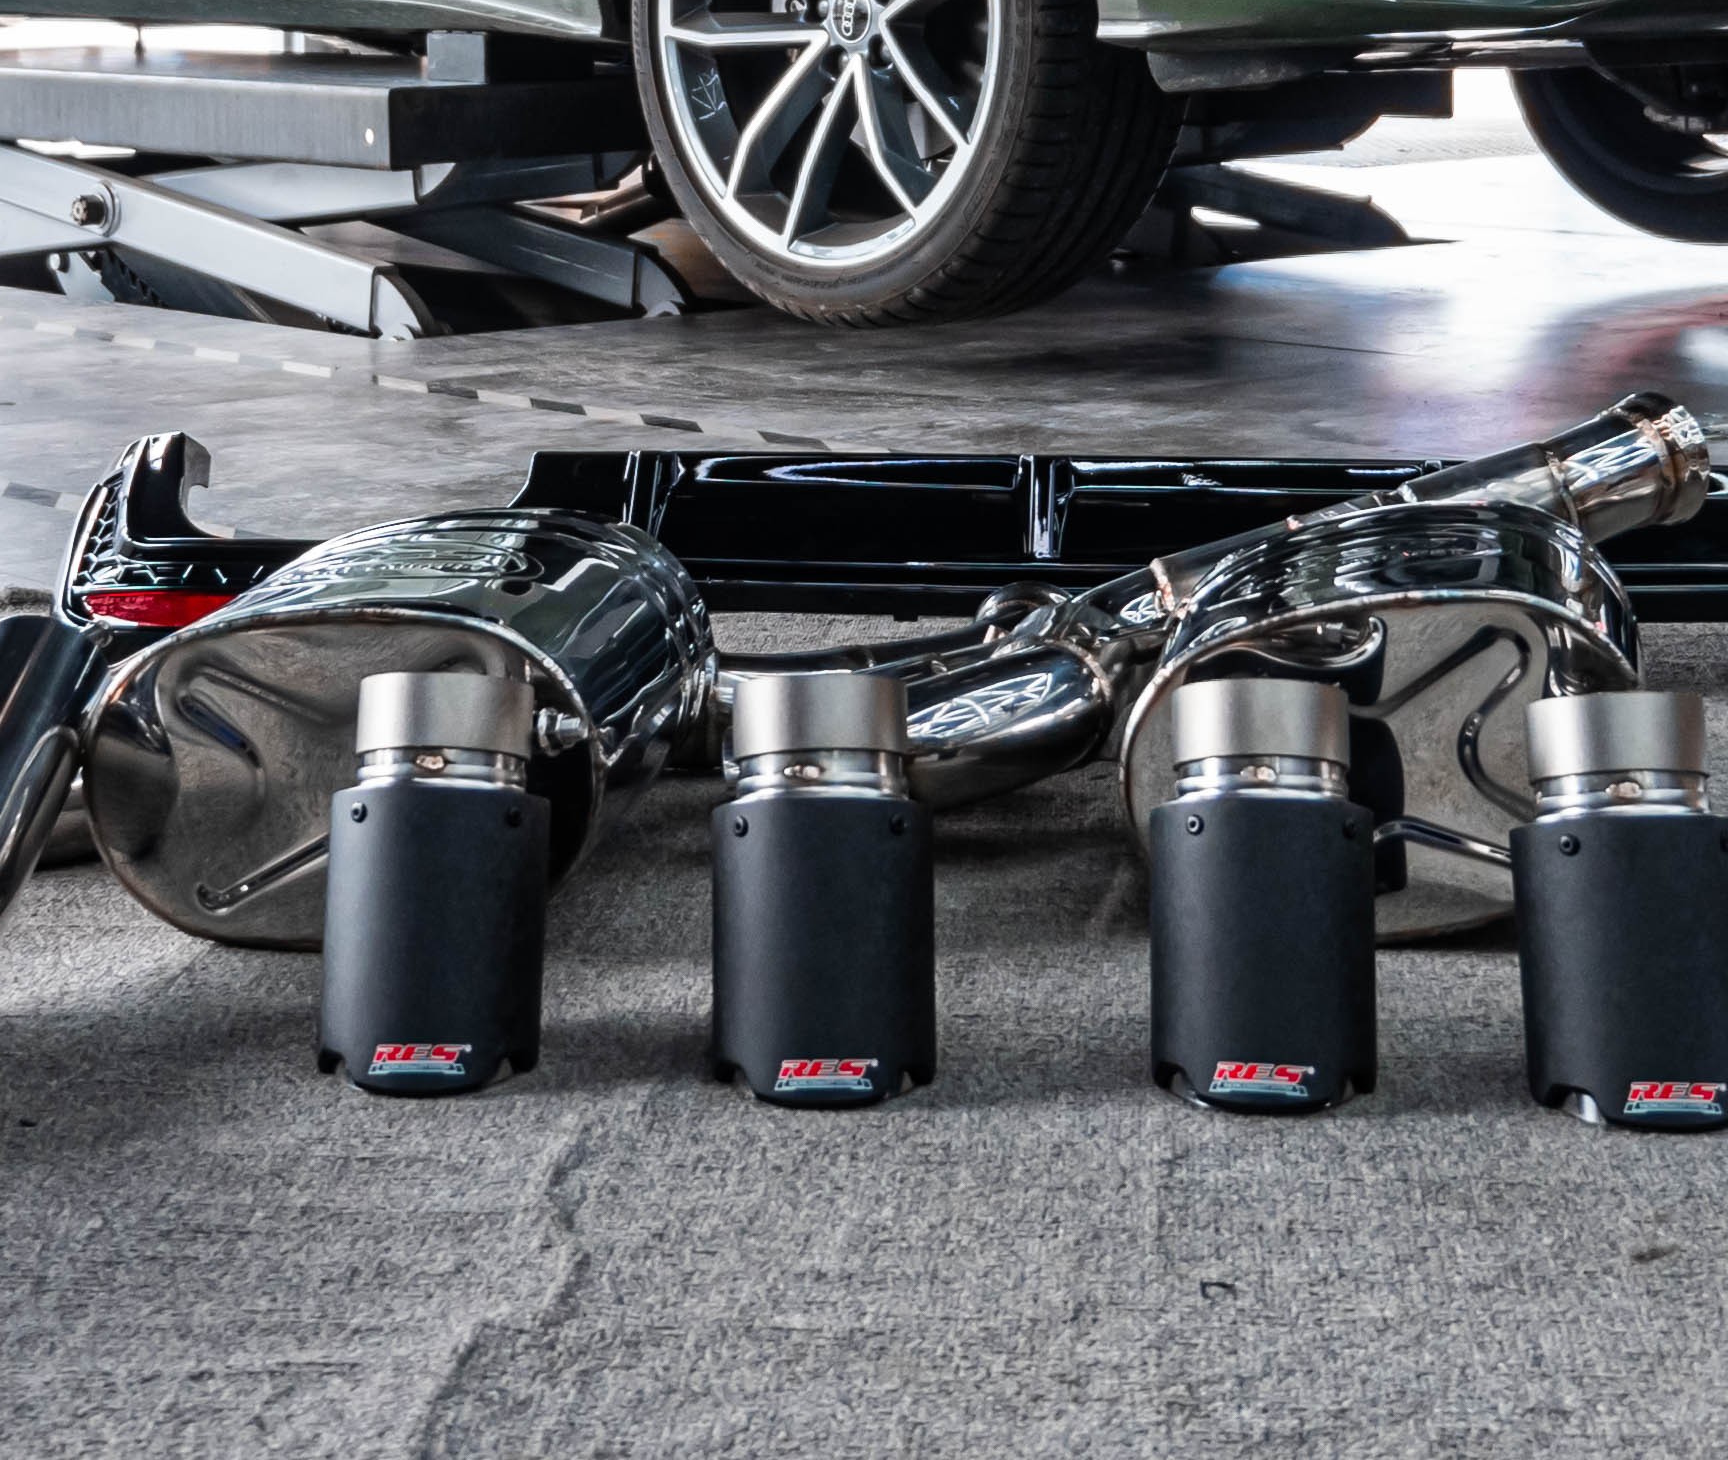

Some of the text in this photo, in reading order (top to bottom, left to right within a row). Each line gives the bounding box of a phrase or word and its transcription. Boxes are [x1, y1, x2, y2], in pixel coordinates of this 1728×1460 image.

[373, 1043, 465, 1063] RES
[778, 1058, 871, 1080] RES
[1213, 1060, 1309, 1085] RES
[1627, 1081, 1720, 1102] RES
